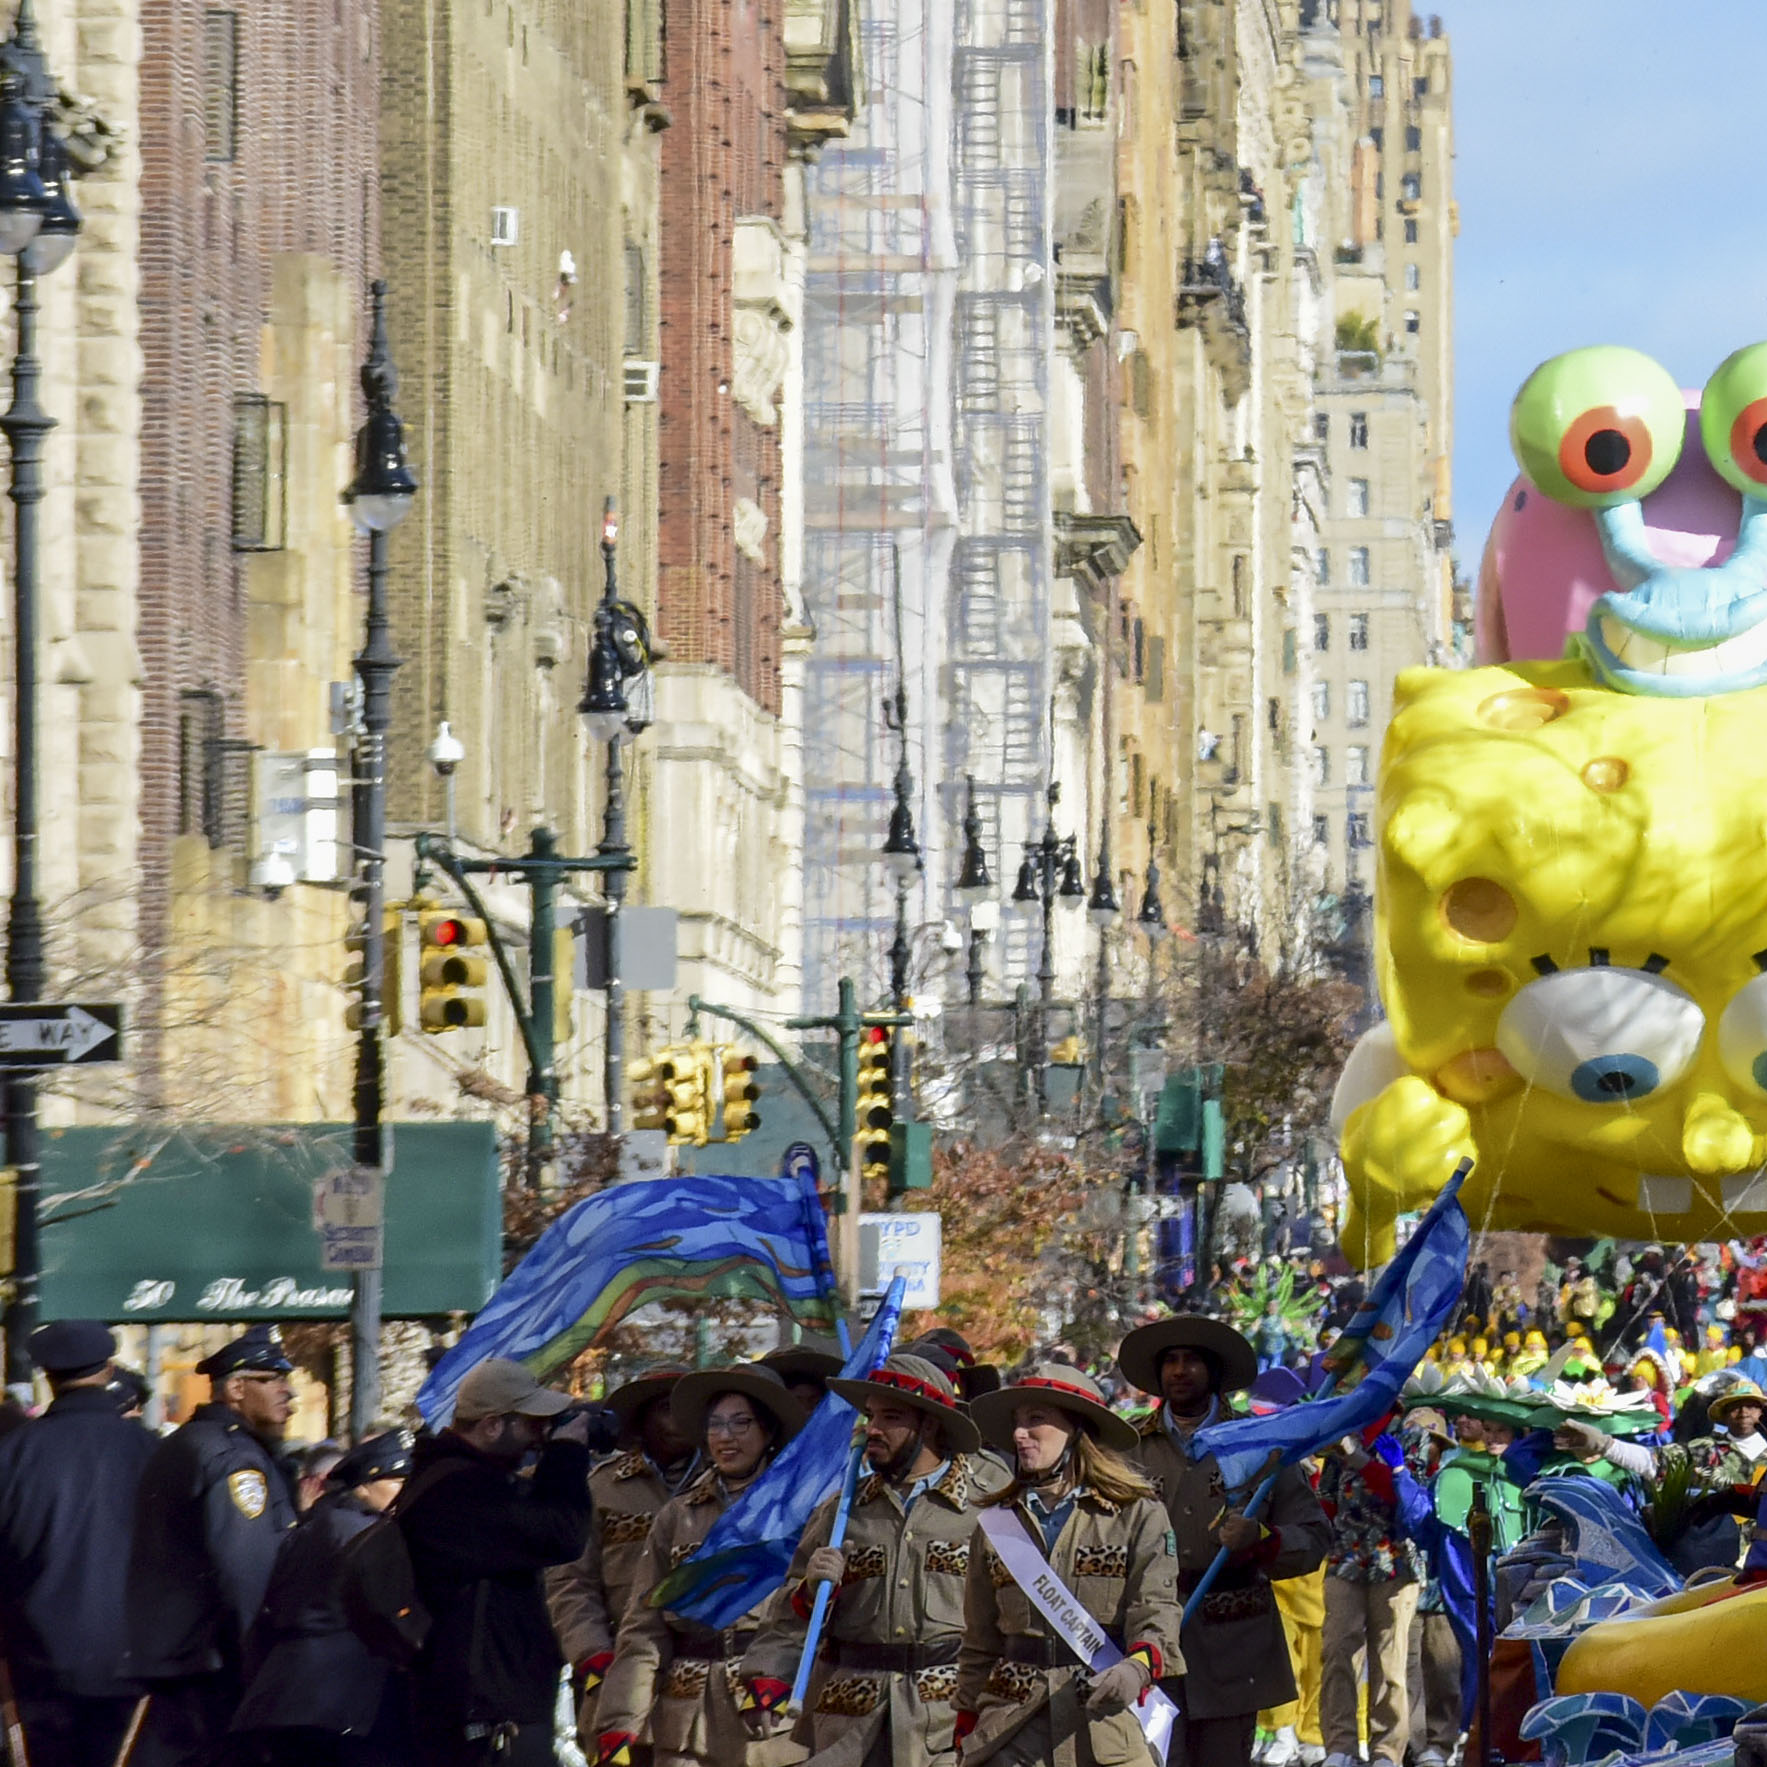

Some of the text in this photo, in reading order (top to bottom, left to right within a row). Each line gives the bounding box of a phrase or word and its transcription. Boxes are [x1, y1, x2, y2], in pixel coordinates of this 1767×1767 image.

[880, 1221, 920, 1237] YPD
[1032, 1573, 1105, 1653] FLOAT CAPTAIN
